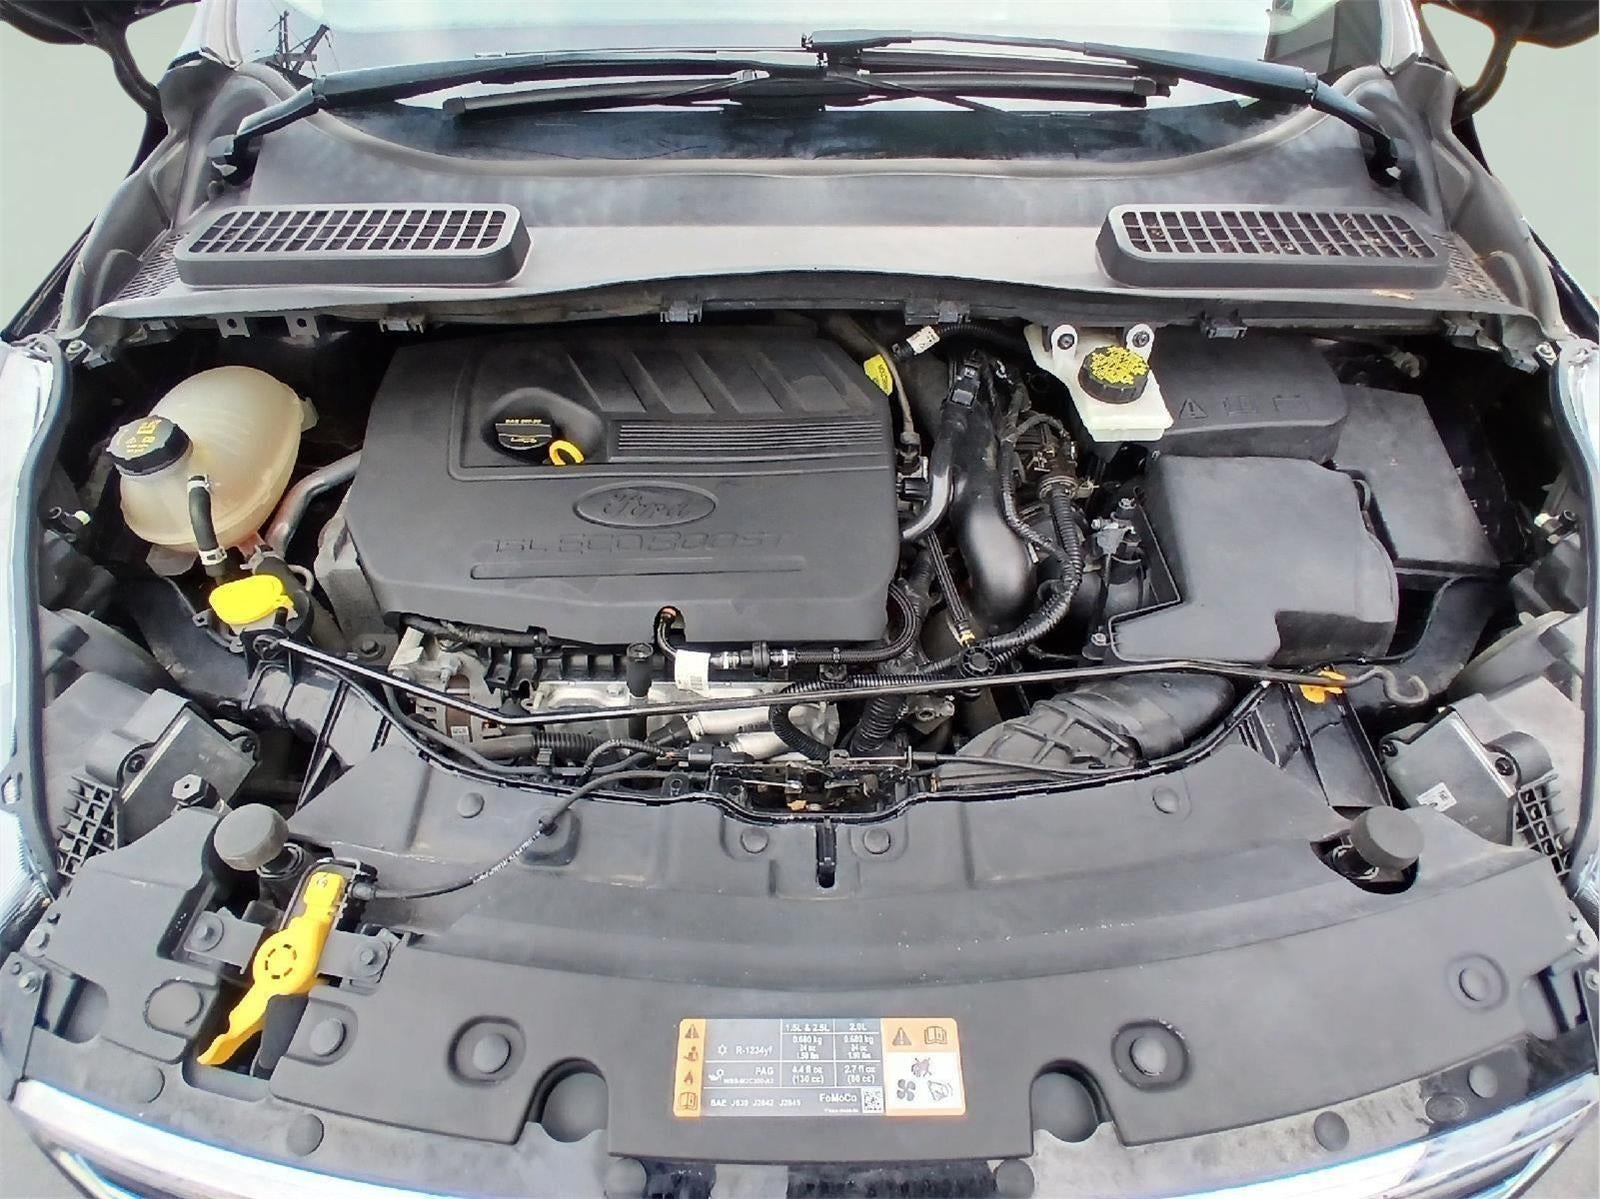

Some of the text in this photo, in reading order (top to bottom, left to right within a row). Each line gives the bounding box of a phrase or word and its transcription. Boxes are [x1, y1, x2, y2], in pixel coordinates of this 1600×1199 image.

[602, 493, 691, 520] Ford
[785, 1023, 802, 1032] 1.5L
[813, 1034, 823, 1045] kg
[735, 1045, 772, 1056] R-1234yf
[755, 1066, 774, 1076] PAG
[844, 1065, 857, 1074] 2.7
[819, 1092, 858, 1103] FoMoCo
